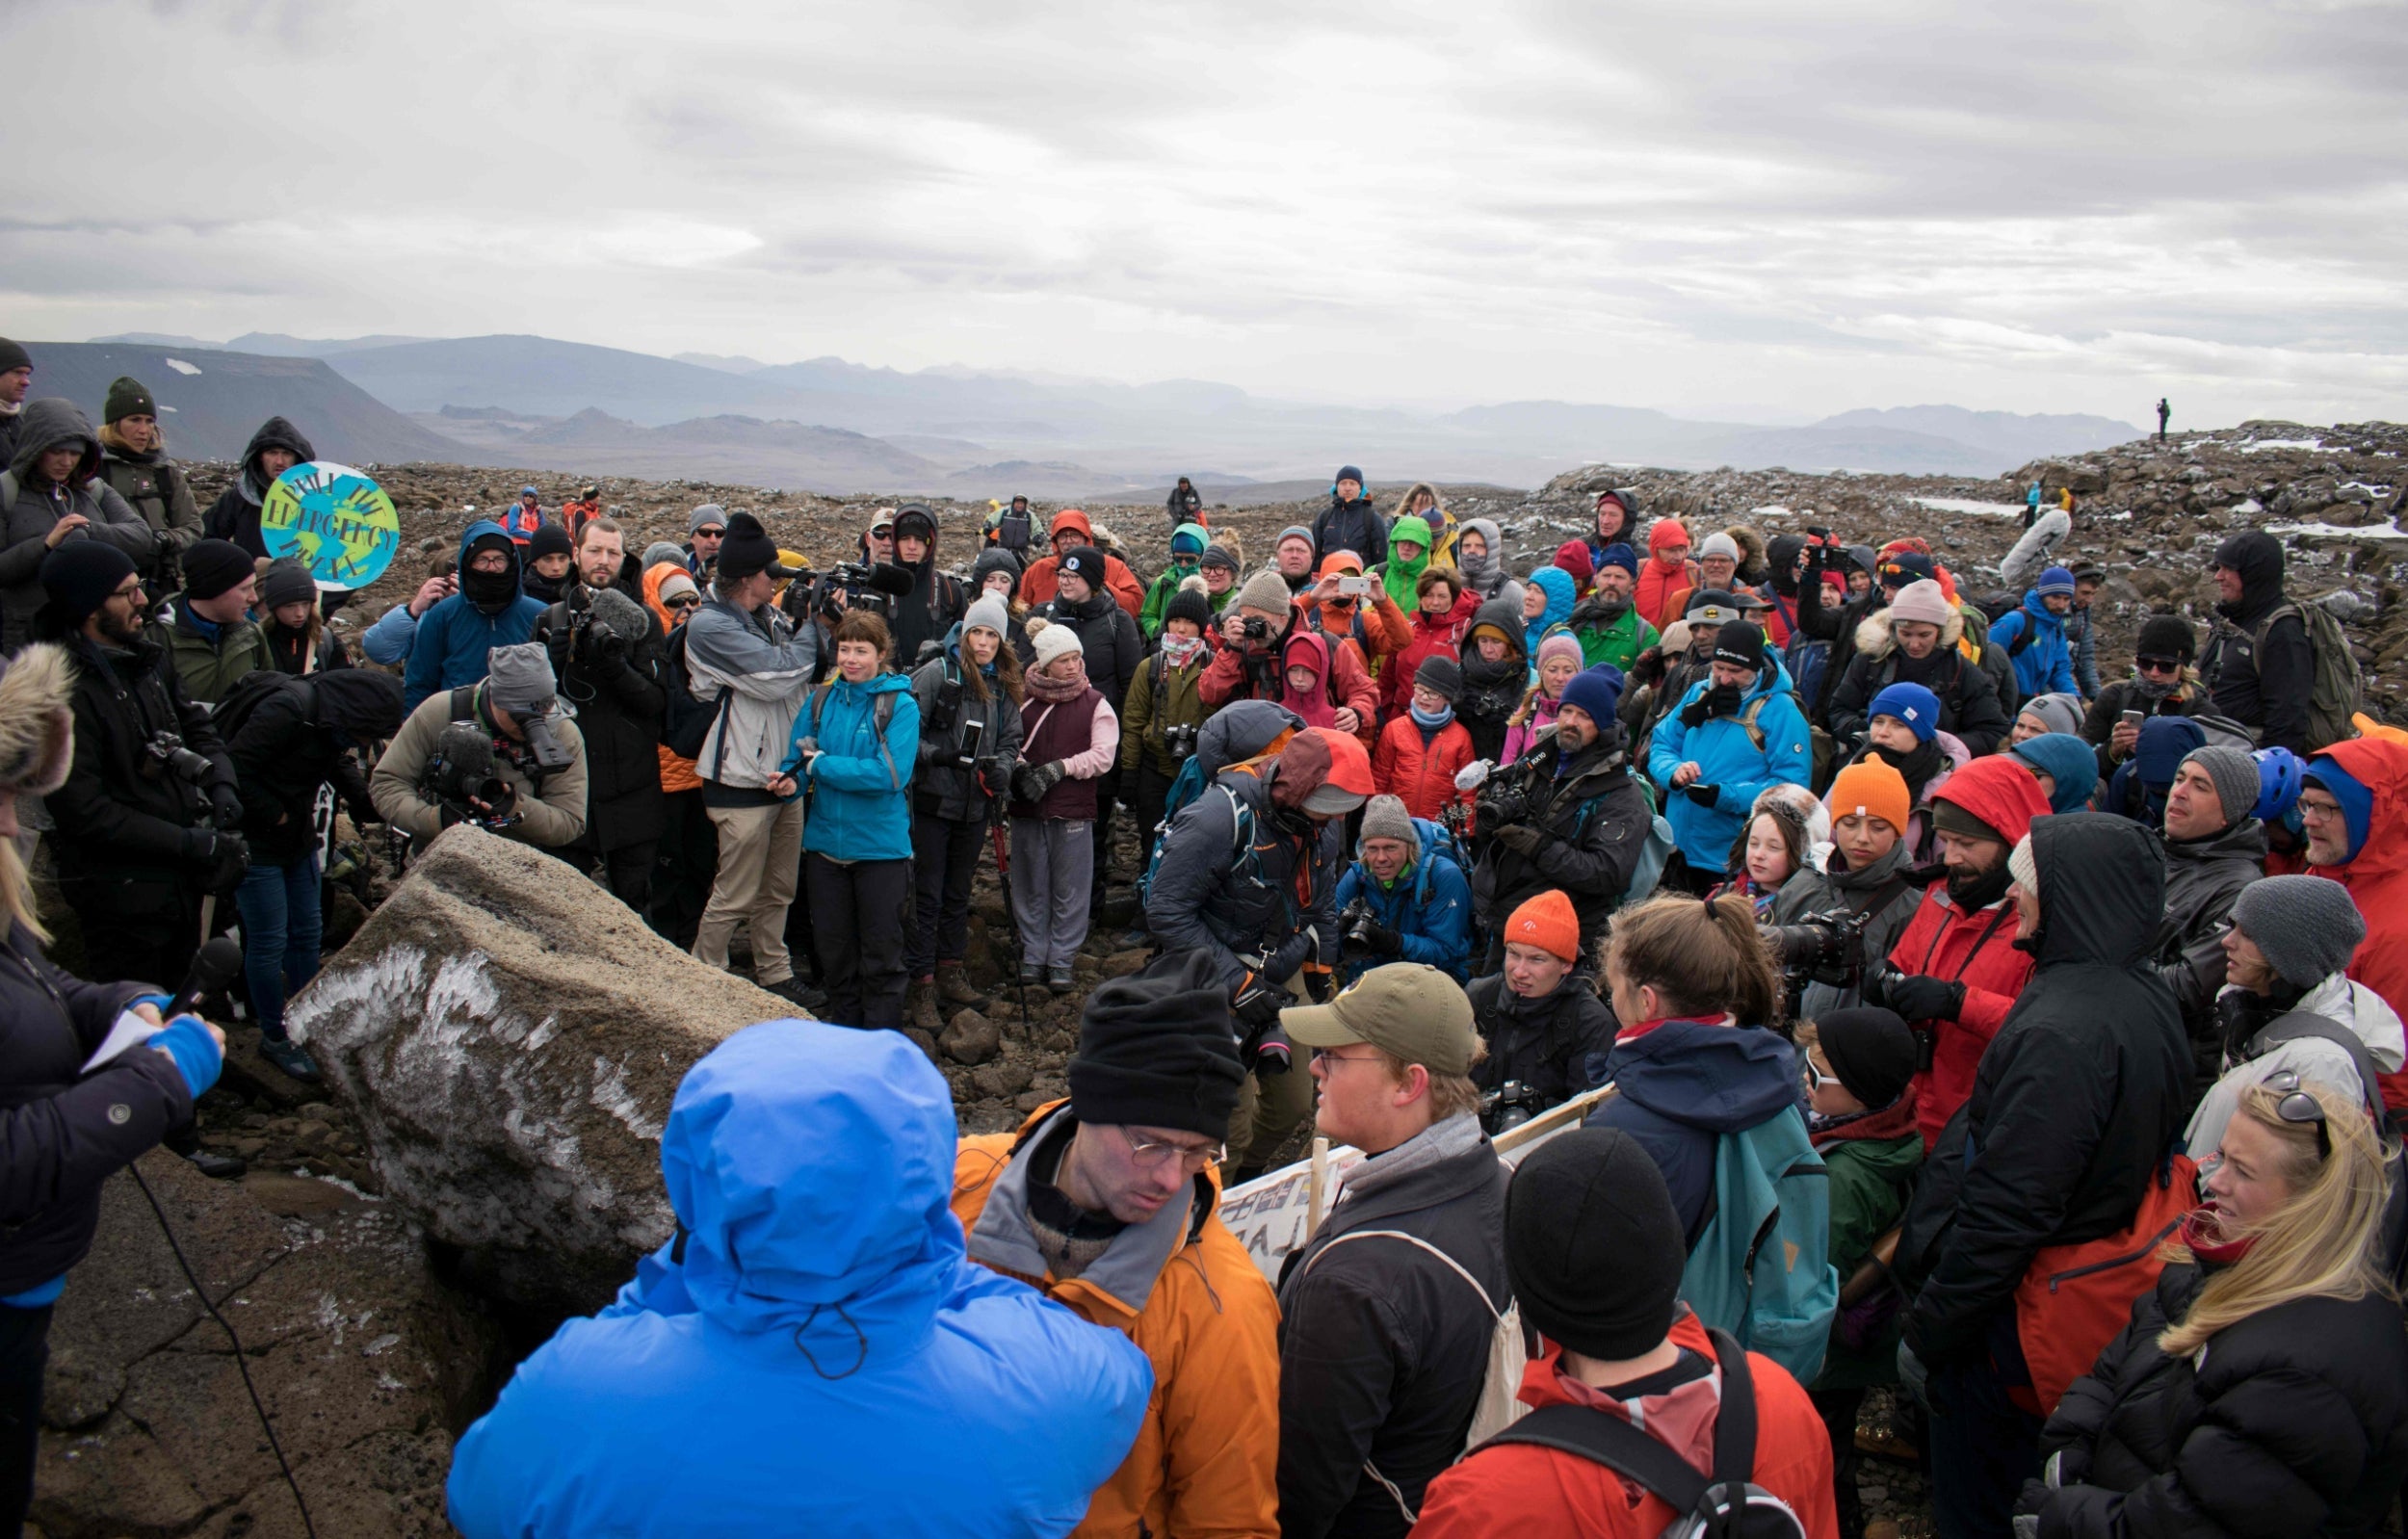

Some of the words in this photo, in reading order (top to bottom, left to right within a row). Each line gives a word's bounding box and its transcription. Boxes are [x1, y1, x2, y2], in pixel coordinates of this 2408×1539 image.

[281, 473, 339, 505] PULL
[348, 483, 387, 523] THE
[267, 499, 393, 551] EMERGENCY
[277, 538, 366, 580] BRAKE
[1531, 751, 1547, 766] RX10
